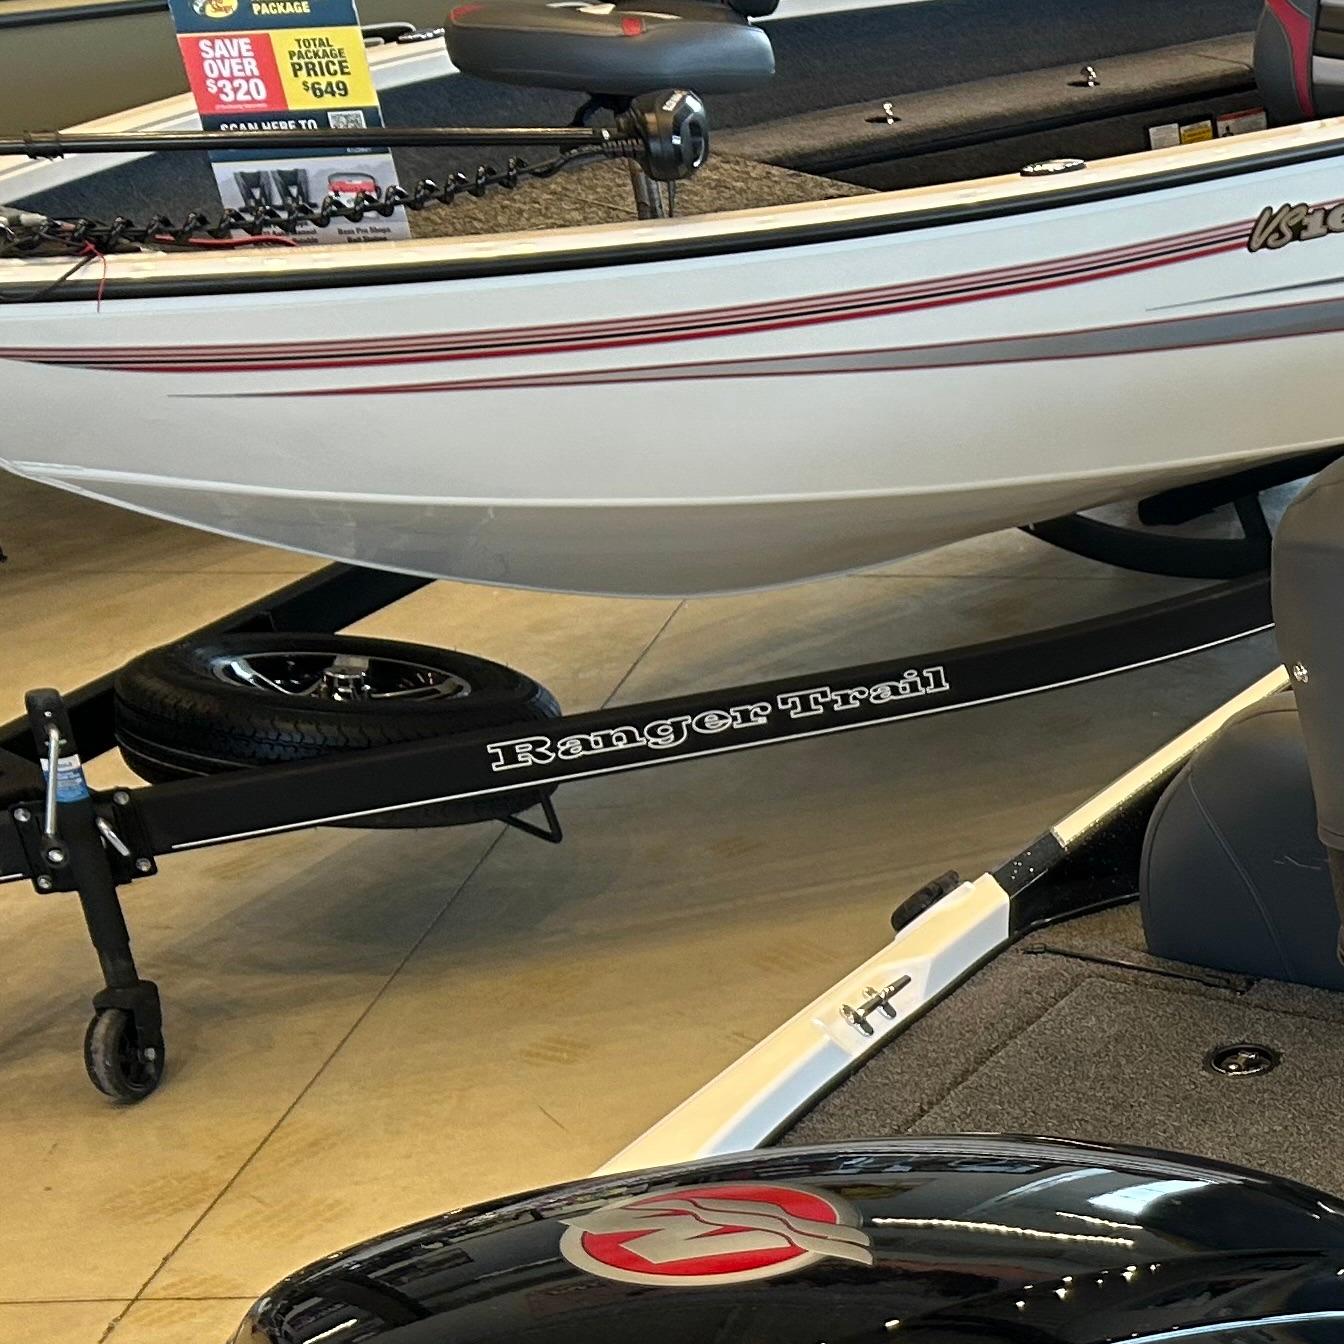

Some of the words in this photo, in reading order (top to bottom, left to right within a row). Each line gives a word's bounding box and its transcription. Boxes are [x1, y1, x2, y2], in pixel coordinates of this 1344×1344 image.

[251, 1, 311, 16] PACKAGE
[199, 37, 255, 59] SAVE
[295, 38, 334, 49] TOTAL
[288, 47, 346, 61] PACKAGE
[203, 56, 260, 79] OVER
[291, 60, 352, 78] PRICE
[206, 78, 267, 102] $320
[302, 80, 349, 99] $649
[487, 700, 772, 772] Ranger
[777, 665, 950, 720] Trail
